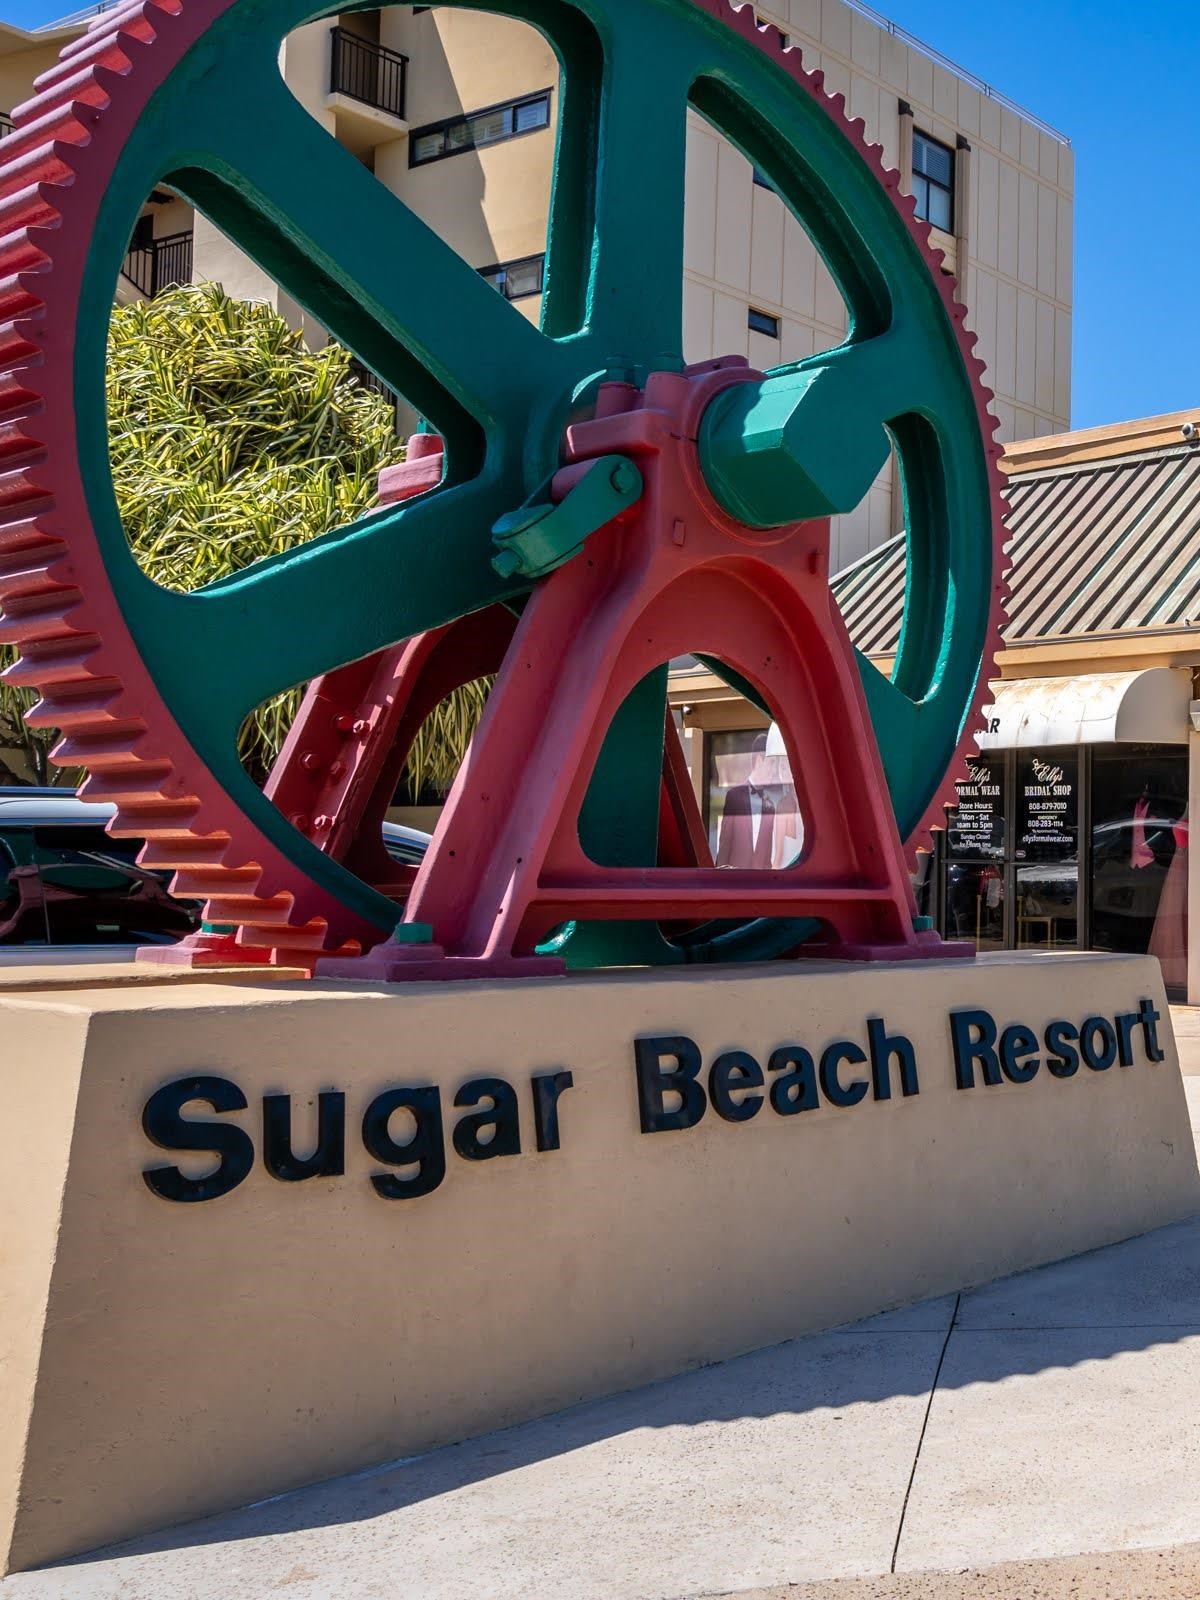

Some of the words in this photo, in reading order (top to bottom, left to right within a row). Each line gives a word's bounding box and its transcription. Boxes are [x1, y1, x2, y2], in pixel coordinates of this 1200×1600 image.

[955, 786, 979, 796] ORMAL
[981, 786, 1000, 796] WEAR
[1024, 786, 1051, 797] BRIDAL
[1053, 785, 1071, 796] SHOP
[980, 822, 993, 830] 5pm
[141, 1070, 574, 1201] Sugar
[634, 1016, 921, 1133] Beach
[951, 997, 1165, 1090] Resort
